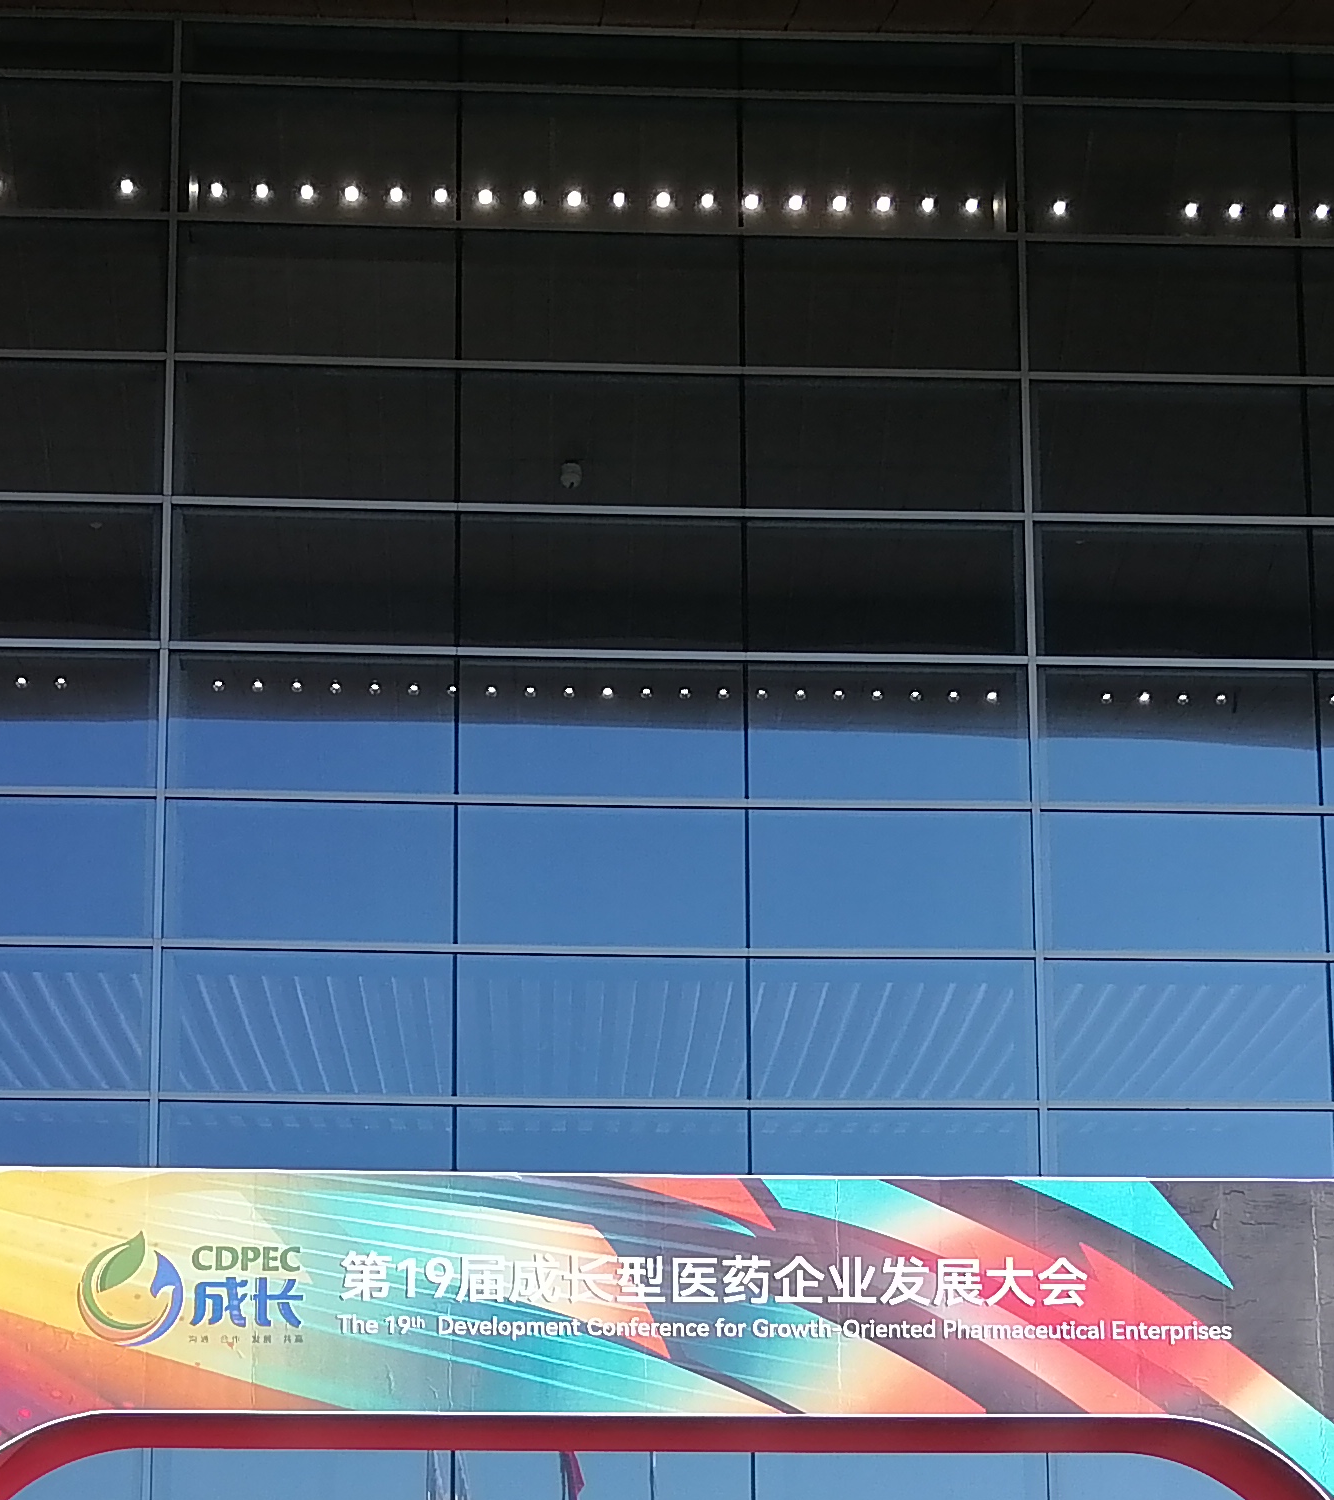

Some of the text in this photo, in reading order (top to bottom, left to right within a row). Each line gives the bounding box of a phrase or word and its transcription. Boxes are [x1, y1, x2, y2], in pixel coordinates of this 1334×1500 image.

[191, 1245, 301, 1272] CDPEC
[339, 1250, 1088, 1307] 第19届成长型医药企业发展大会
[189, 1276, 304, 1329] 成长
[336, 1314, 1233, 1344] The 19th Development Conference for Growth-Oriented Pharmaceutical Enterprises
